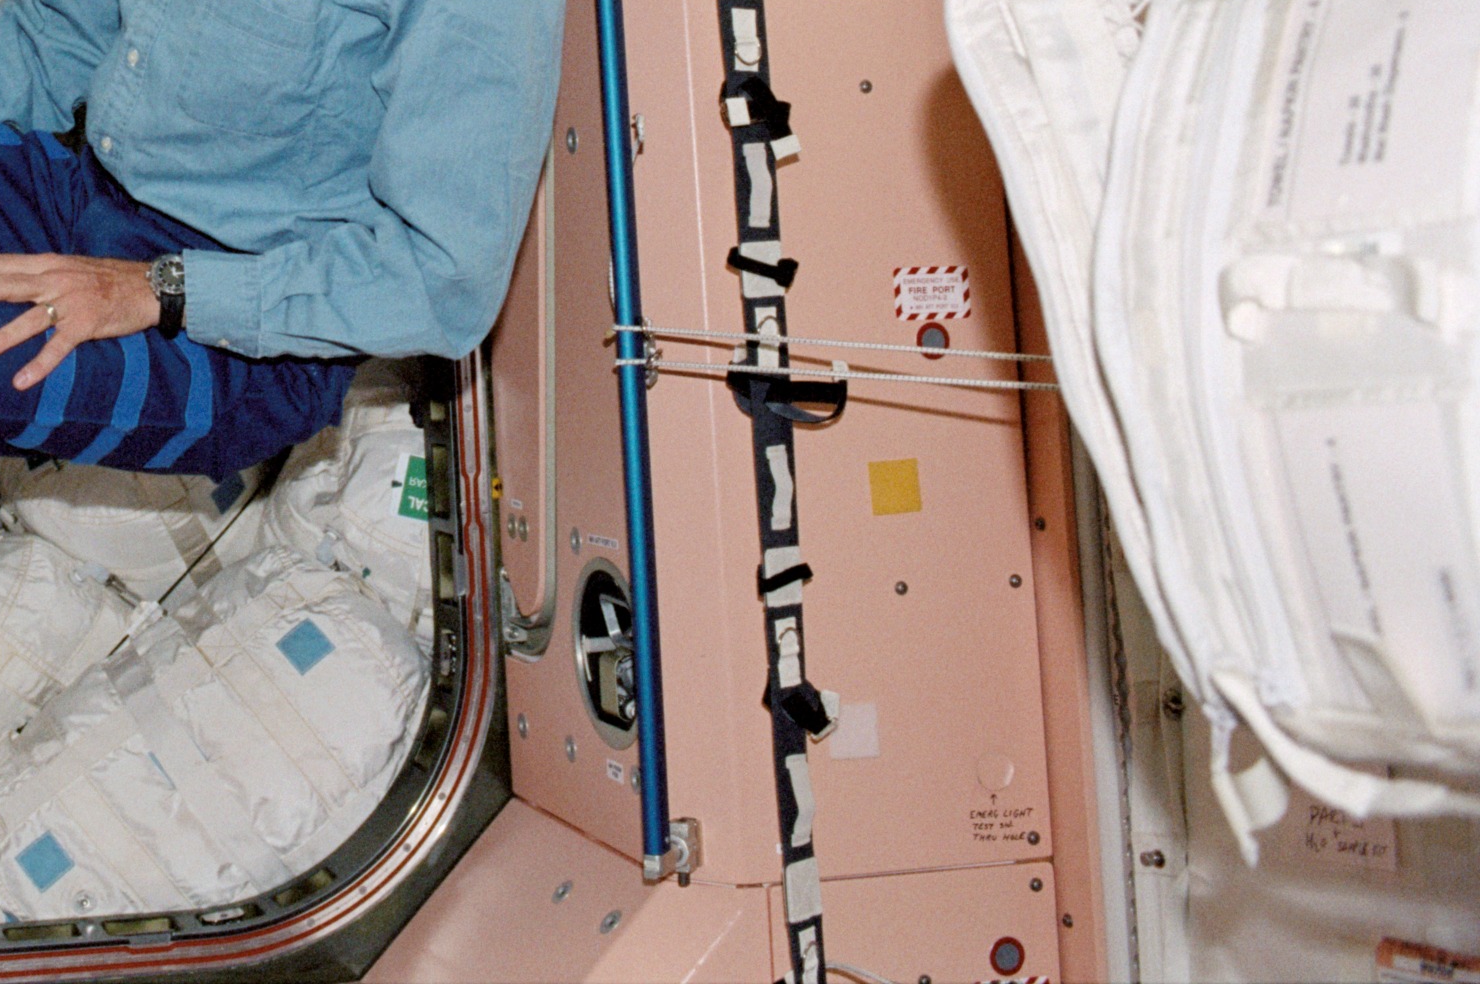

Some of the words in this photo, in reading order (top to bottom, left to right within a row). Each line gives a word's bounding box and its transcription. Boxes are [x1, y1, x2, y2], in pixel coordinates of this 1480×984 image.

[908, 286, 927, 294] FIRE
[970, 809, 998, 819] EMERG
[1003, 807, 1034, 817] LIGHT
[973, 833, 997, 841] THRU
[1002, 832, 1026, 841] HOLE
